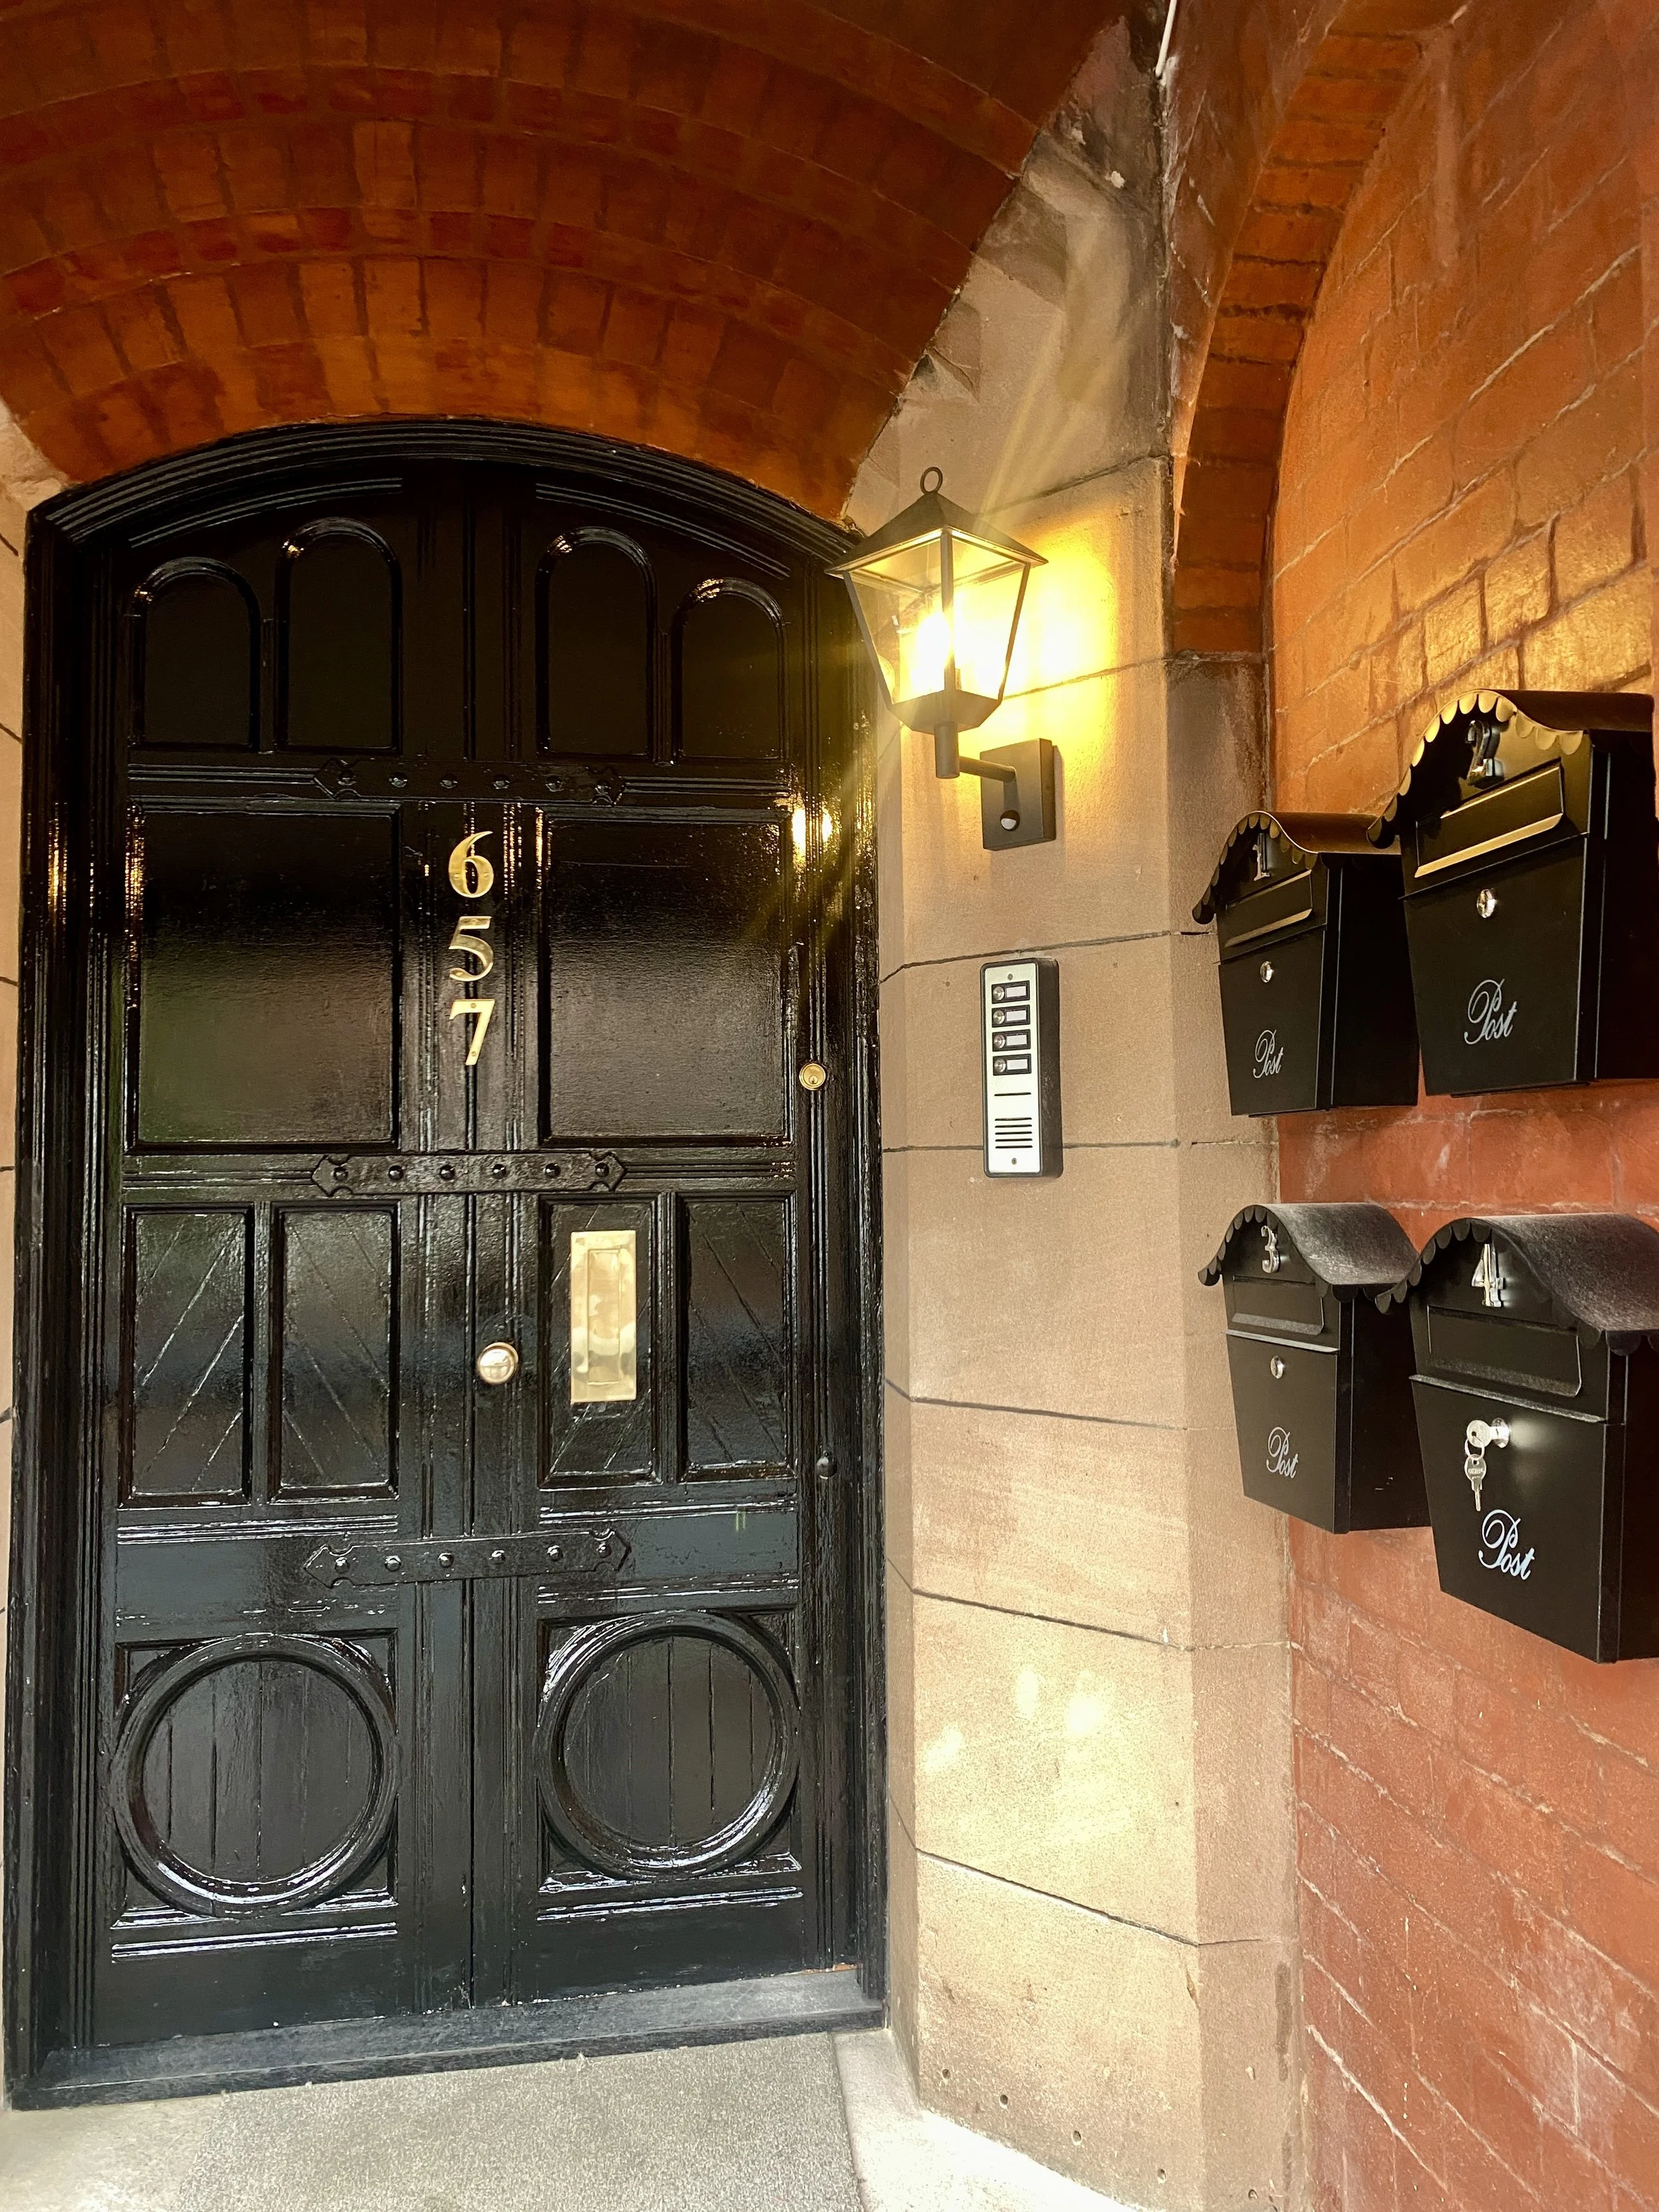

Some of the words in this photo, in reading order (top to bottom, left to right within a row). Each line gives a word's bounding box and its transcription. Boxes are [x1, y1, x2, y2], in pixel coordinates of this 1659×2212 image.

[1465, 719, 1501, 786] 2
[1252, 832, 1270, 881] 1
[1464, 979, 1517, 1044] Post
[1253, 1029, 1283, 1078] Post
[1261, 1225, 1279, 1273] 3
[1471, 1243, 1504, 1307] 4
[1266, 1427, 1298, 1479] Post
[1479, 1509, 1535, 1580] Post
